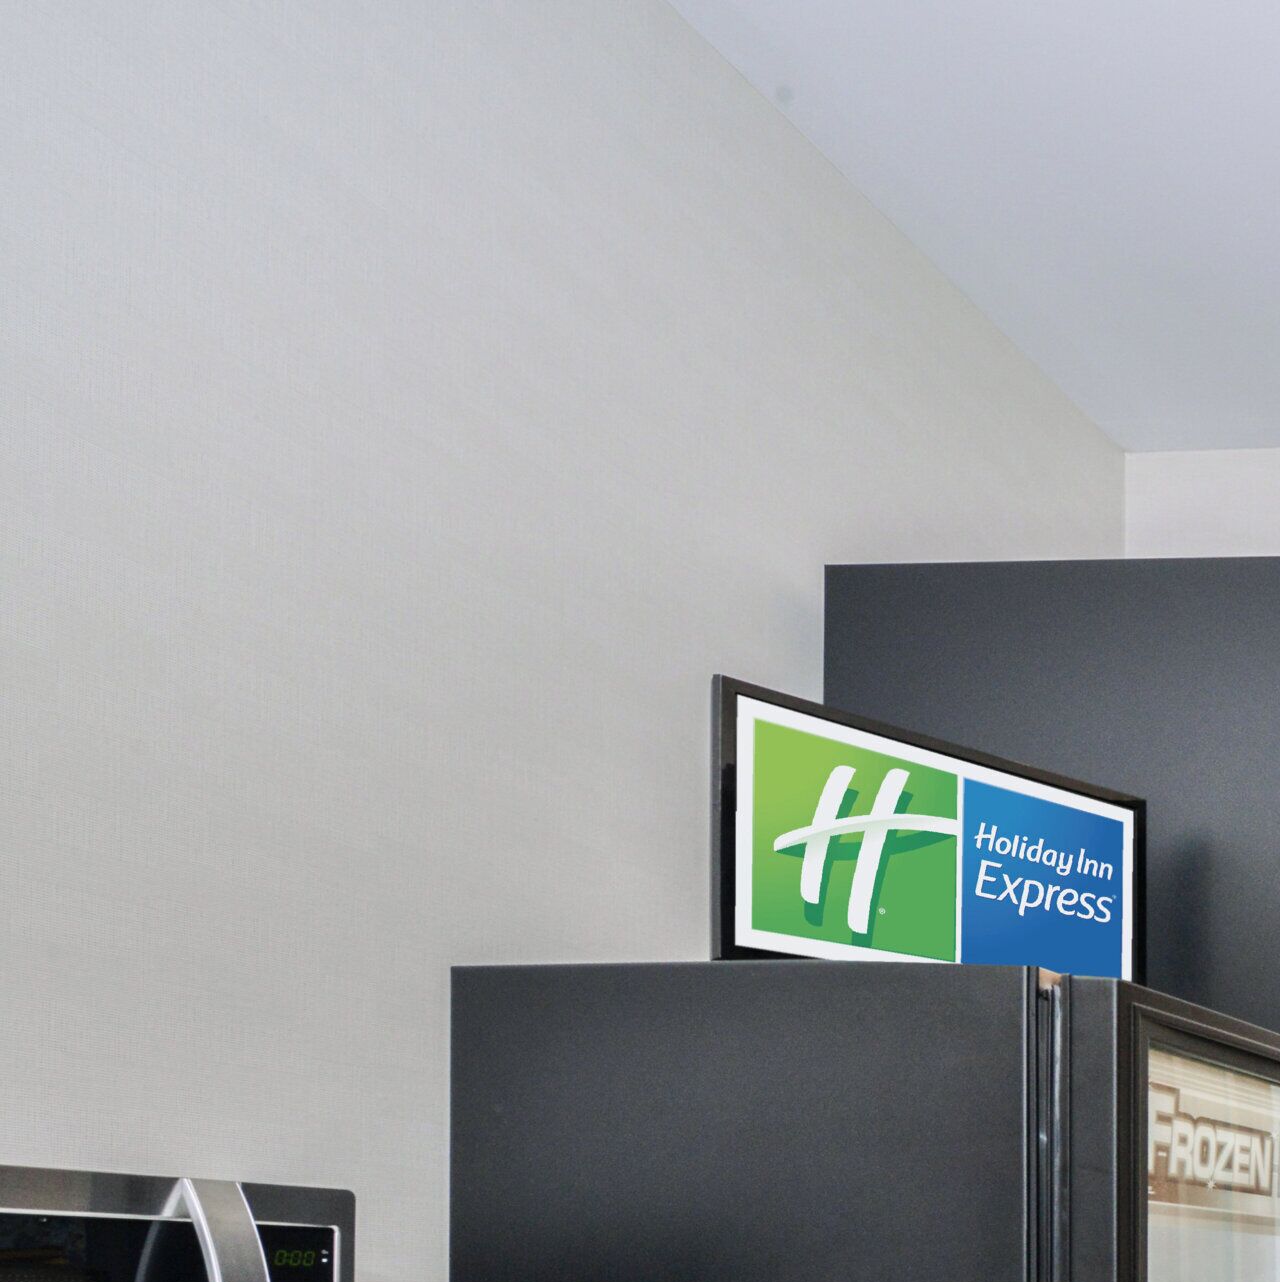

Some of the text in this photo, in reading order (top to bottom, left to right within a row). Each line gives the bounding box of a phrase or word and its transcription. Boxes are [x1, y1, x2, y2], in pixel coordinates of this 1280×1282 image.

[974, 822, 1114, 880] Holiday Inn
[974, 859, 1114, 923] Express
